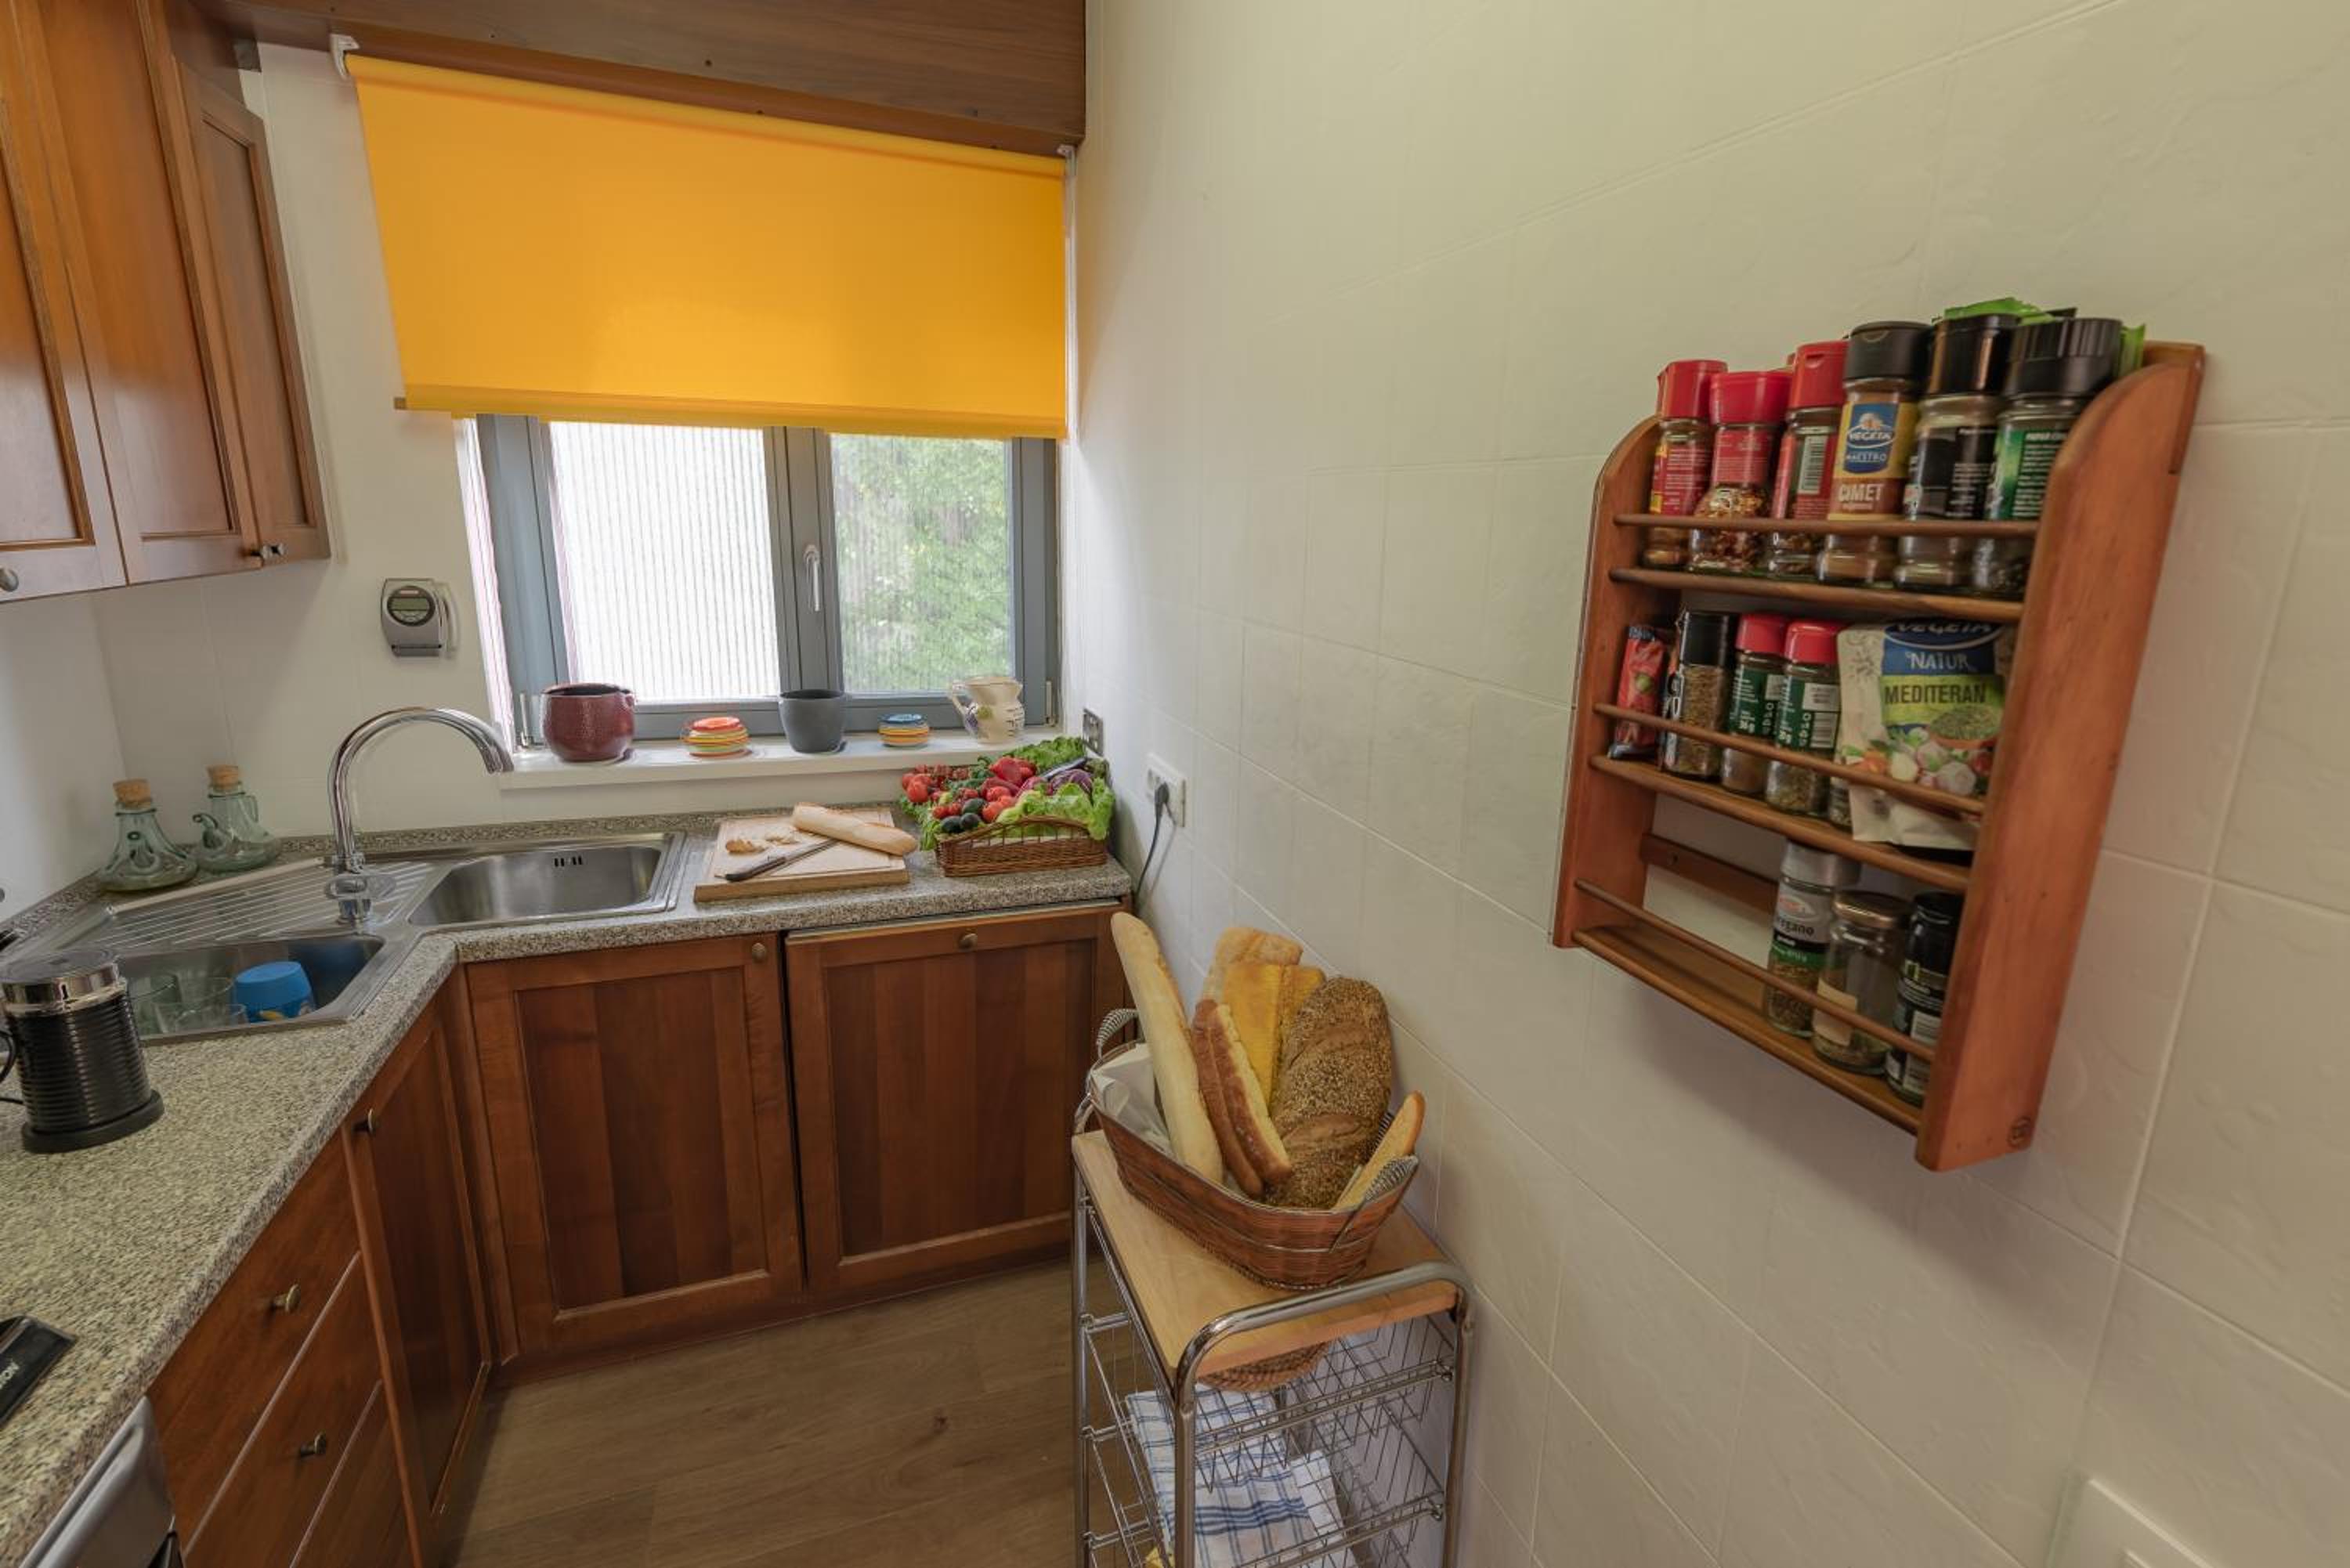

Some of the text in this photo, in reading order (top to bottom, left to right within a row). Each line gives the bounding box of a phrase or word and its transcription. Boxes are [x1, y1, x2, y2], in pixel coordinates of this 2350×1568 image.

[1849, 431, 1891, 440] VEGETA
[1846, 451, 1887, 462] MAESTRO
[1905, 652, 1969, 670] NATUR
[1885, 684, 1986, 704] MEDITERAN
